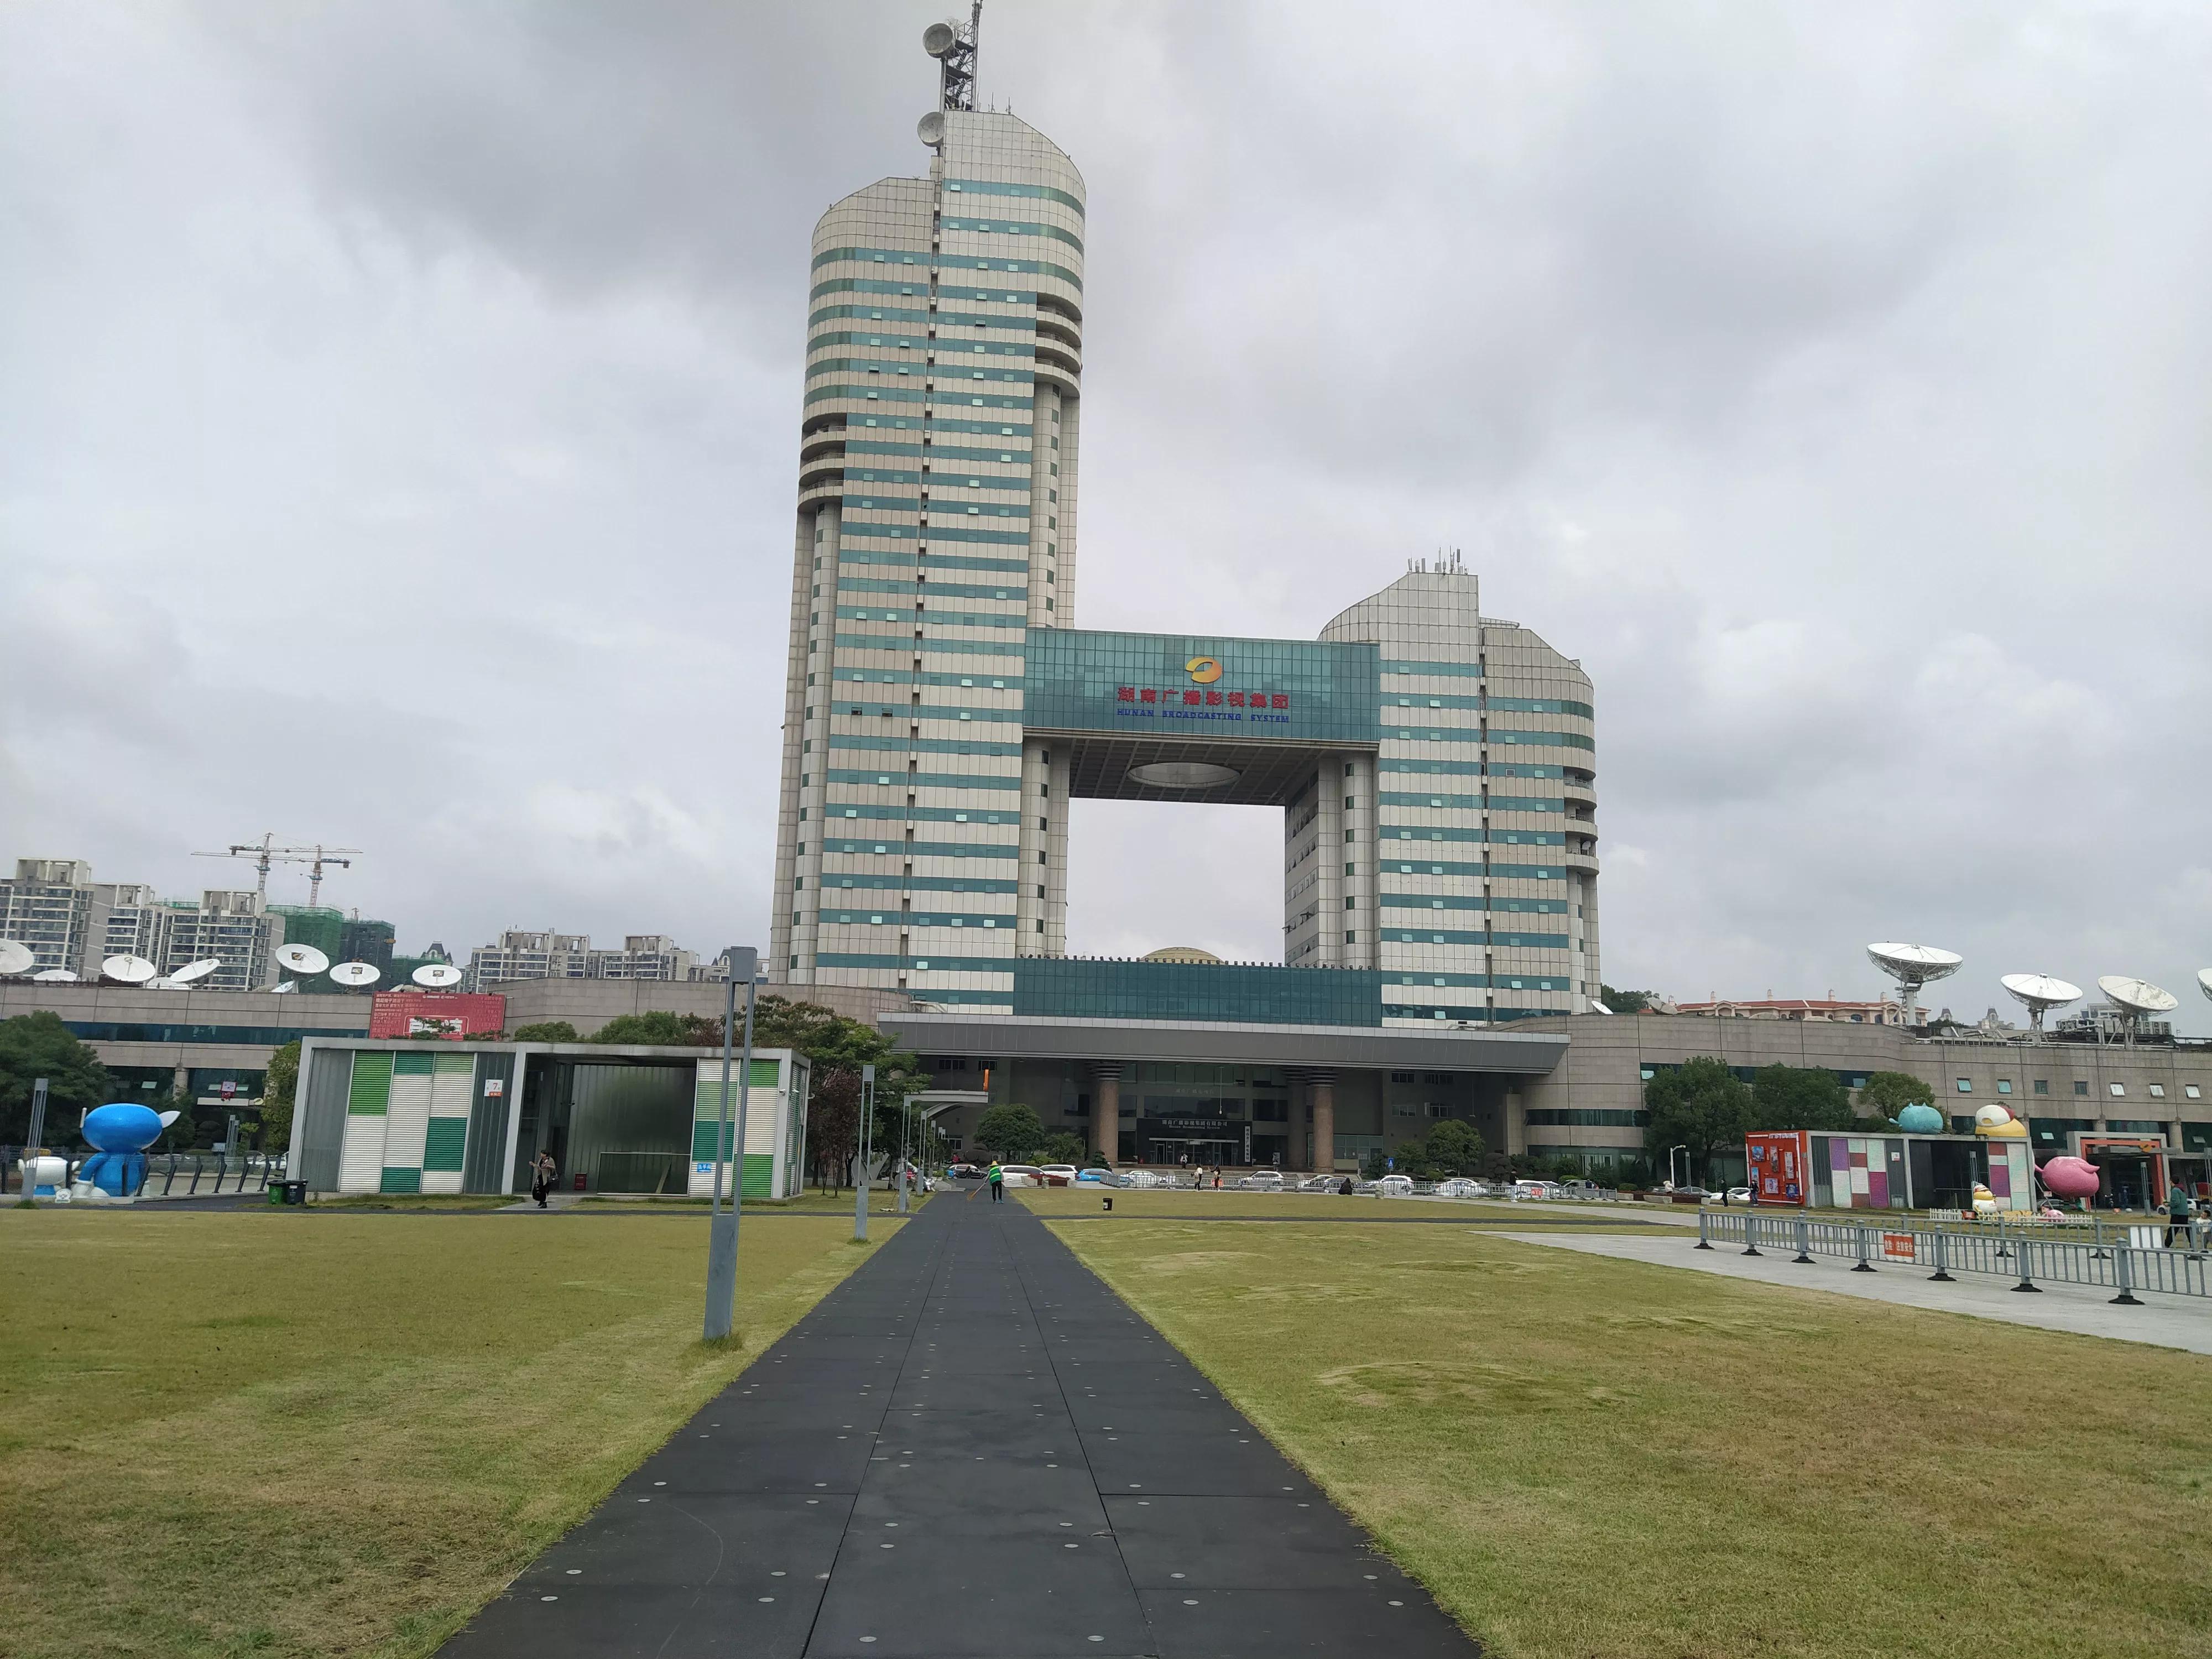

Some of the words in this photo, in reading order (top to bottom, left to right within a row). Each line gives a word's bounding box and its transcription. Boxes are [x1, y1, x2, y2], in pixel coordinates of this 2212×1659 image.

[1117, 687, 1288, 708] 湖南广播影视集团
[1117, 708, 1154, 717] HUNAN
[1162, 710, 1241, 721] BROADCASTING
[1250, 713, 1289, 723] SYSTEM
